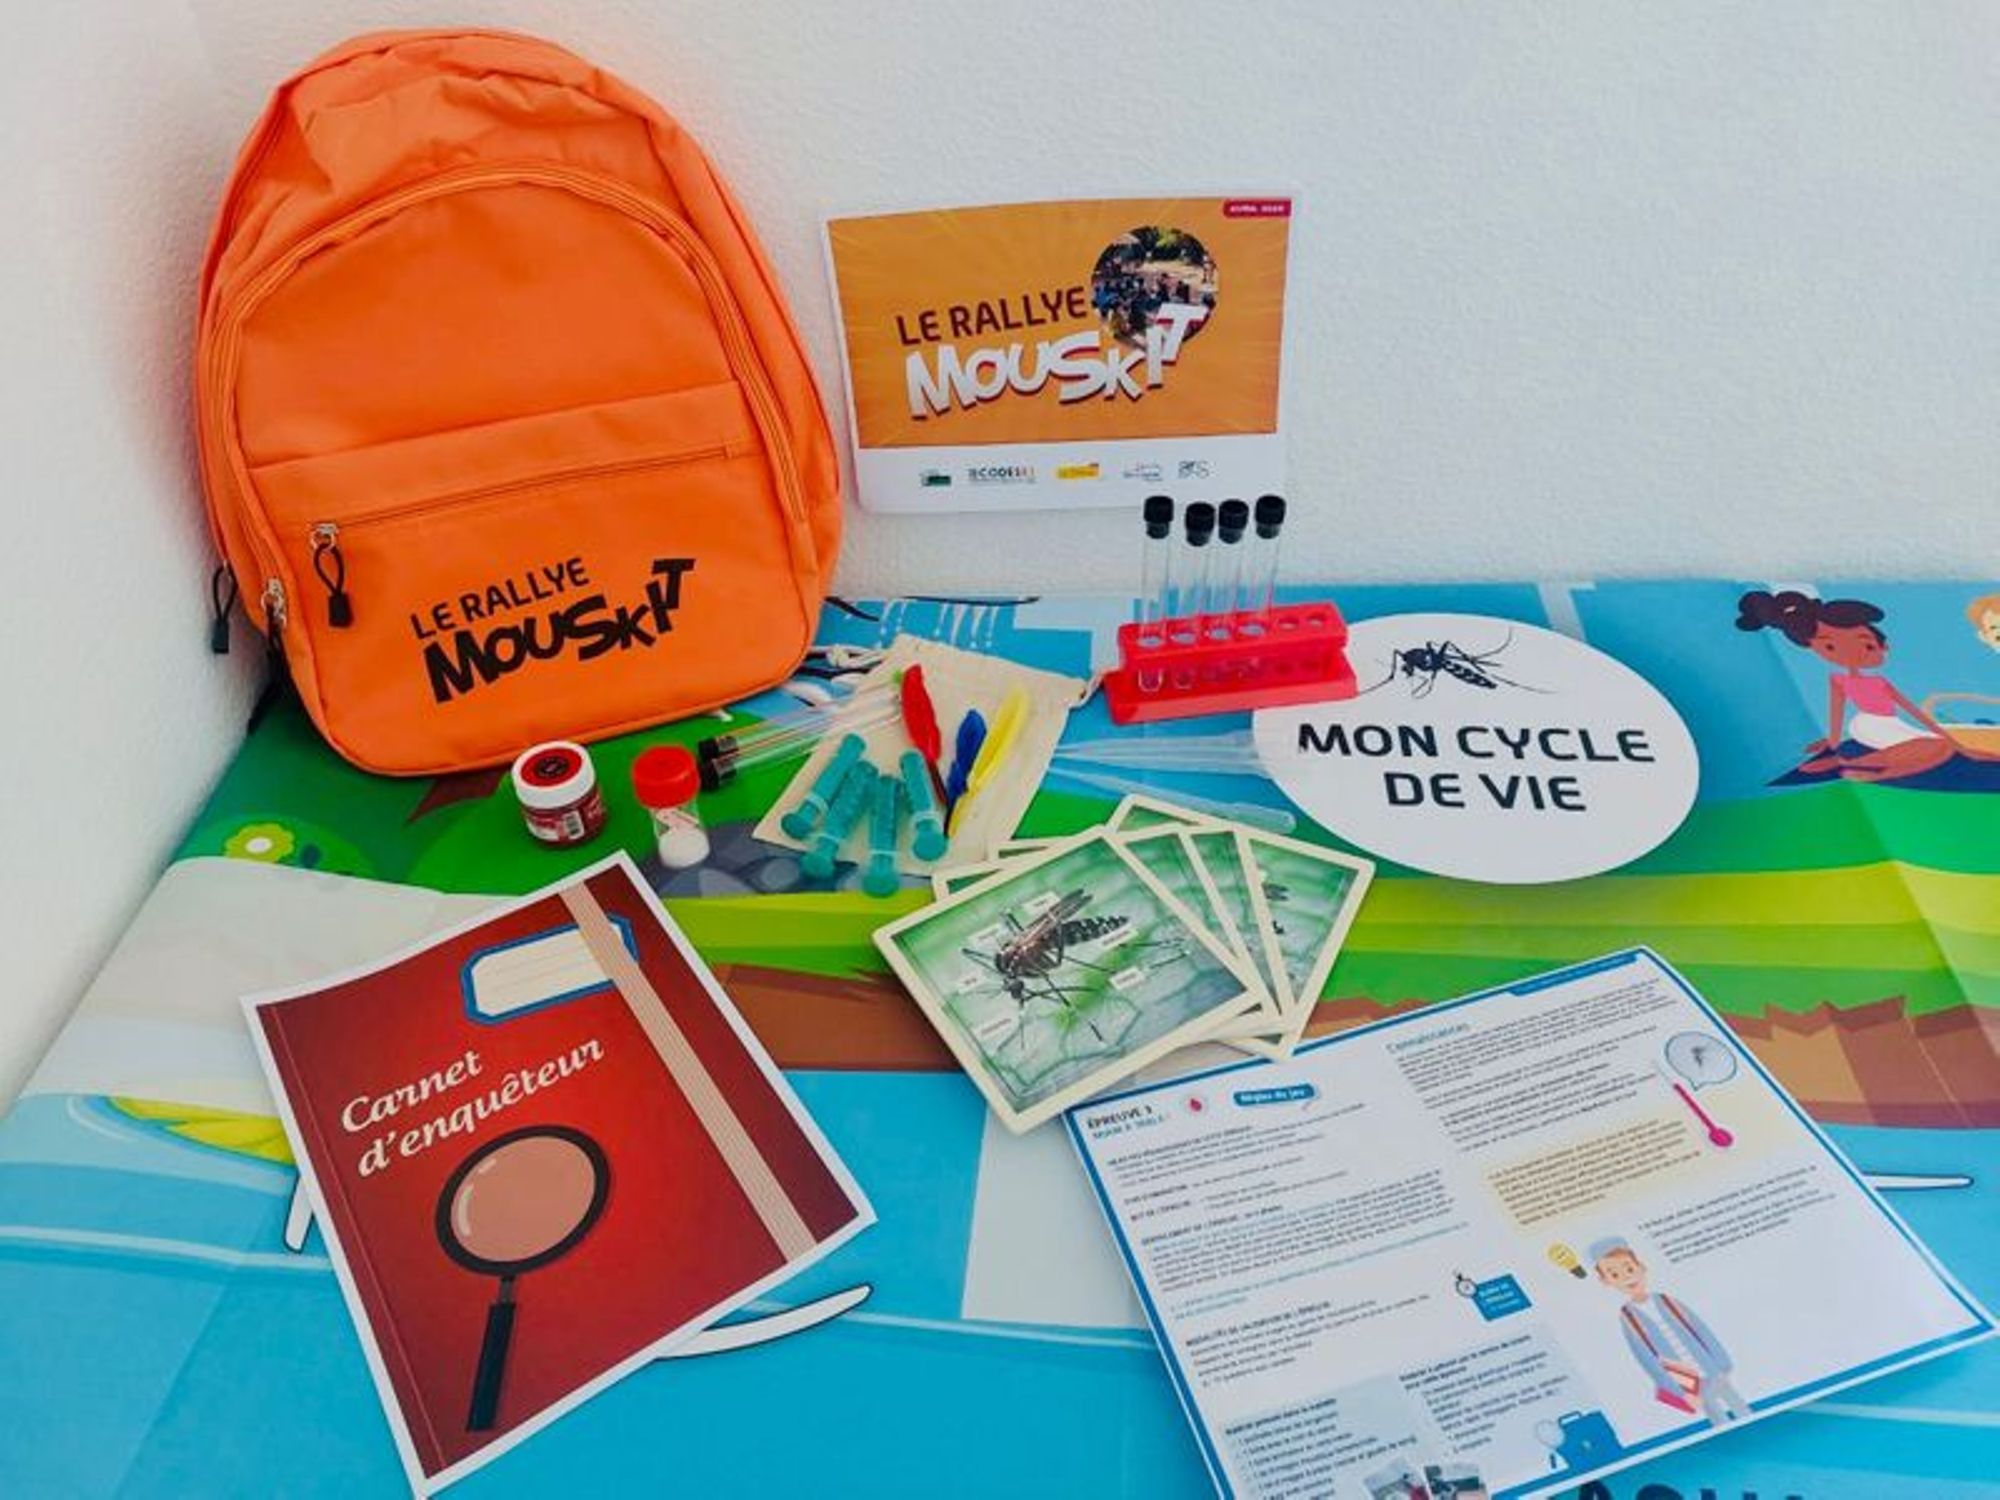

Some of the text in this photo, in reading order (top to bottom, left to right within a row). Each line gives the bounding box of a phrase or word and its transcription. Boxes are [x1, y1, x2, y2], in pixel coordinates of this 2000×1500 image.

[896, 285, 1090, 346] LE RALLYE
[410, 556, 590, 639] LE RALLYE
[1298, 723, 1655, 763] MON CYCLE
[1384, 771, 1586, 812] DE VIE
[341, 1049, 483, 1133] Carnet
